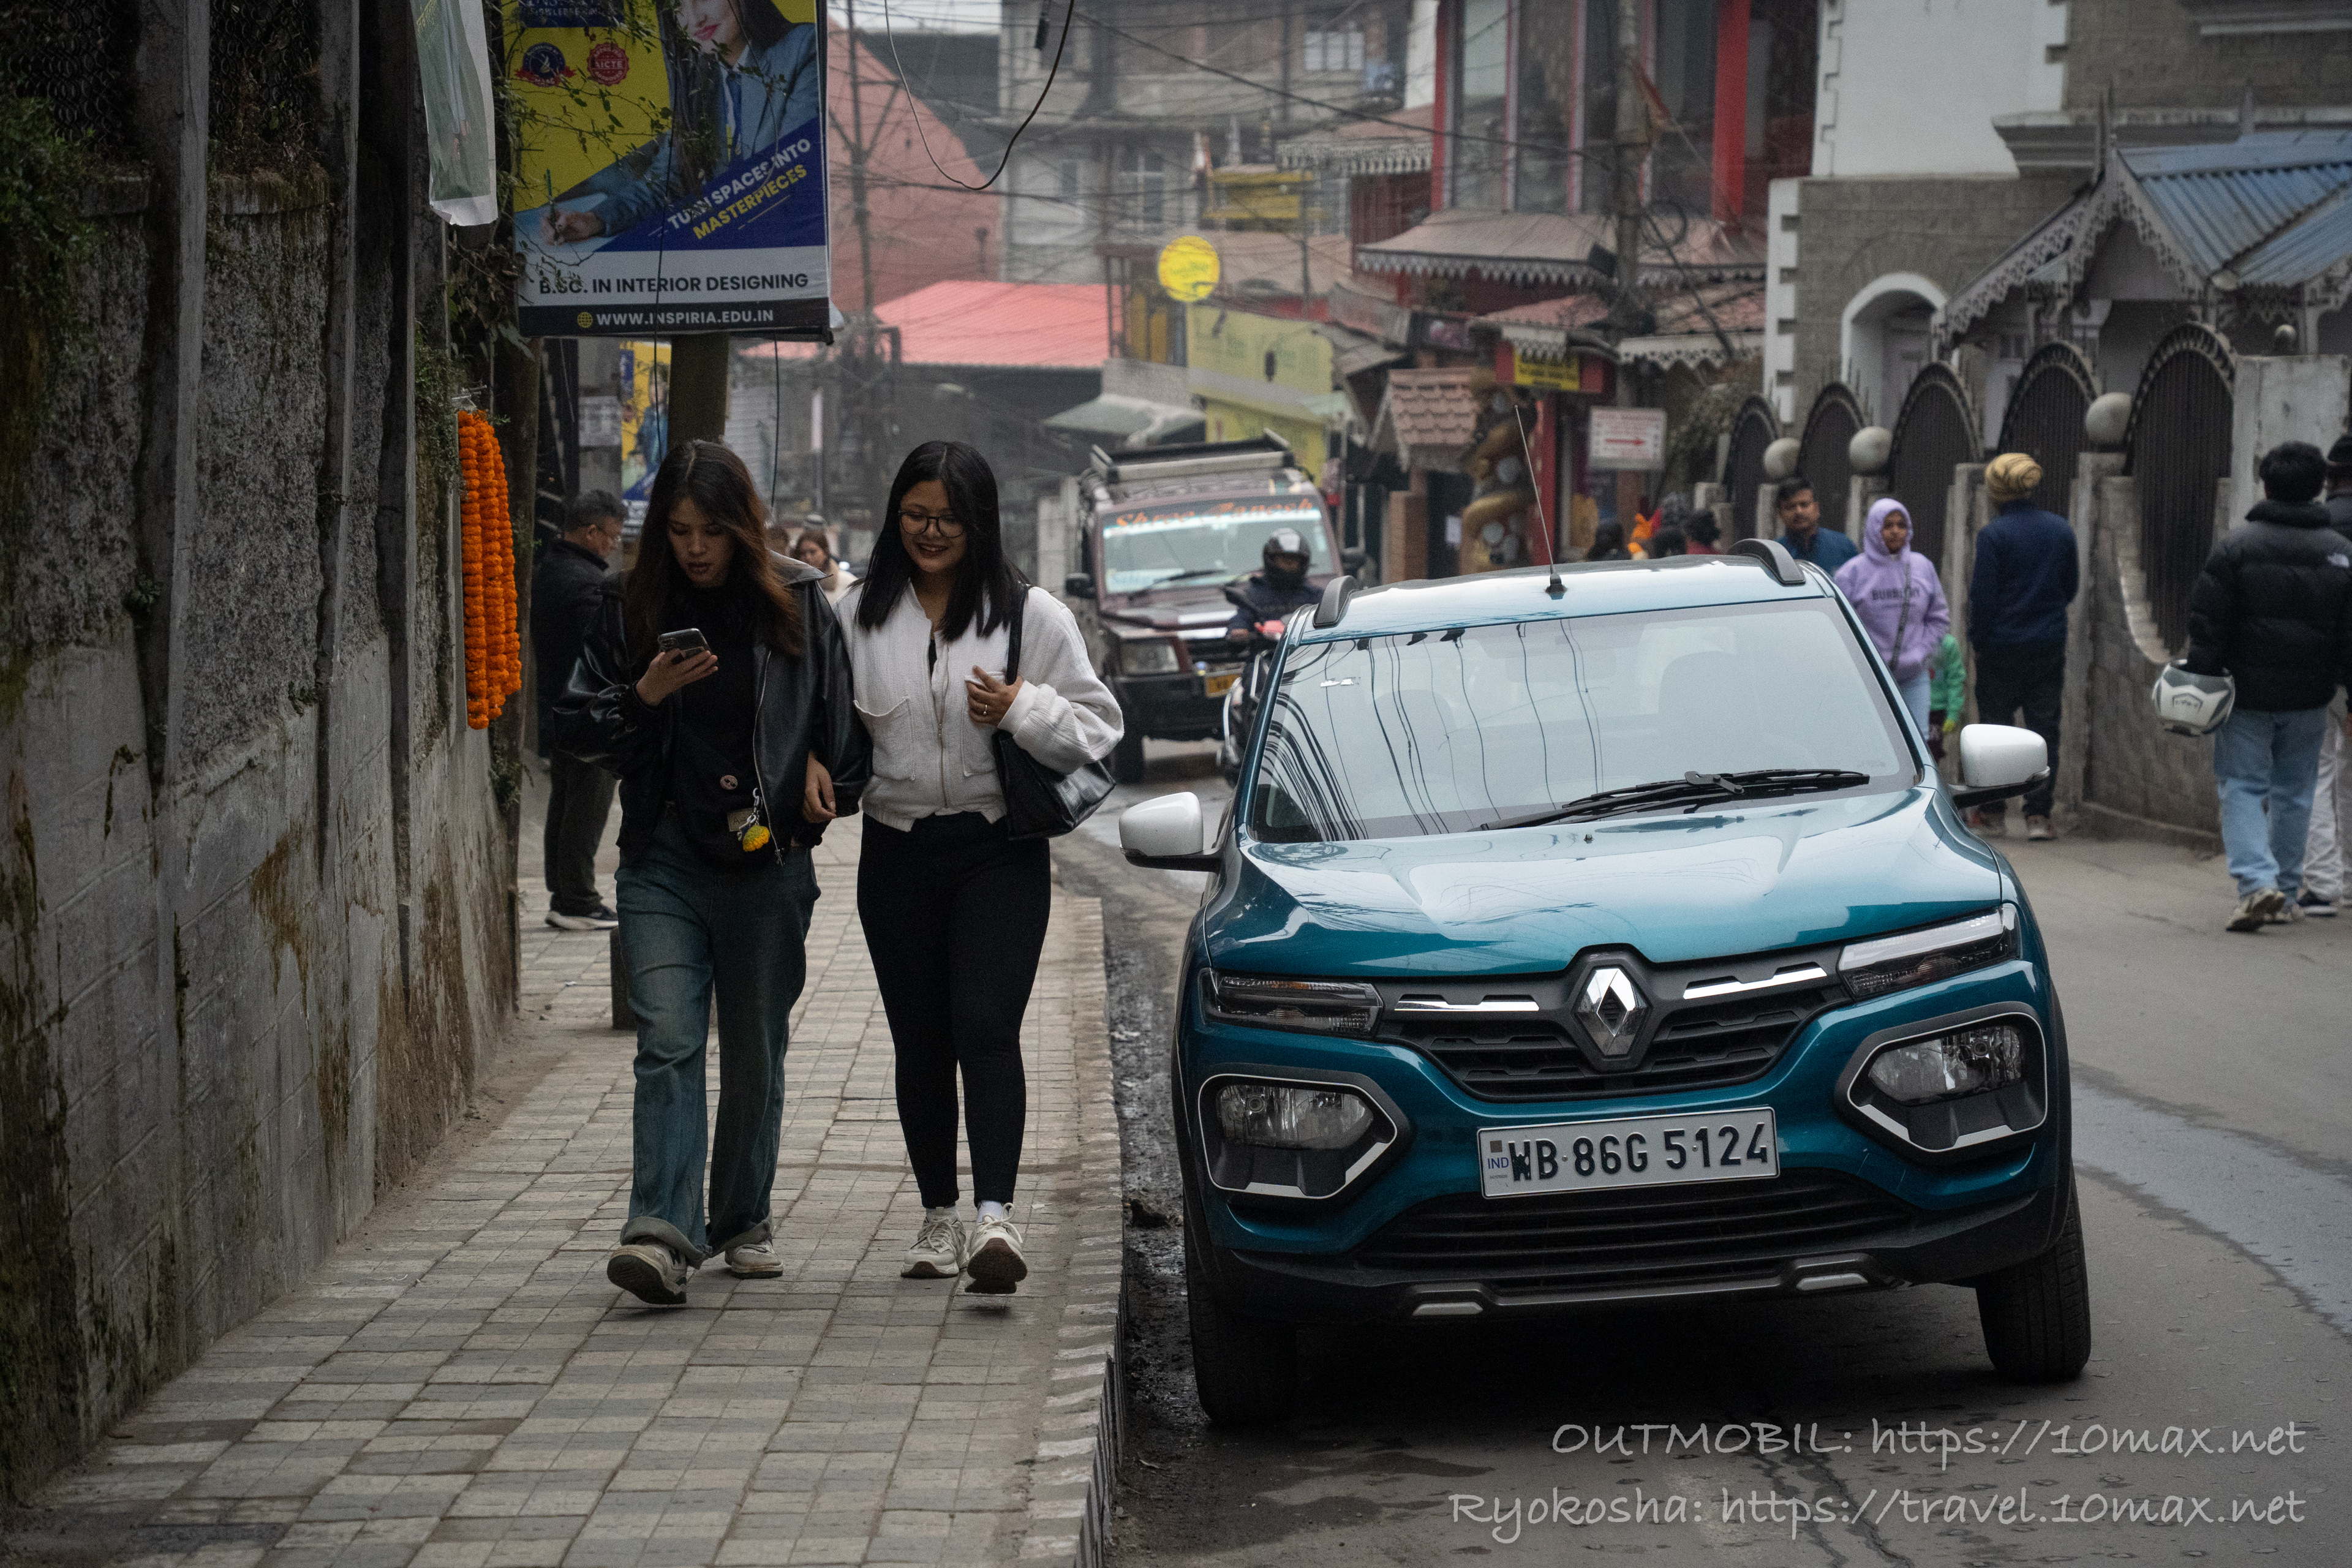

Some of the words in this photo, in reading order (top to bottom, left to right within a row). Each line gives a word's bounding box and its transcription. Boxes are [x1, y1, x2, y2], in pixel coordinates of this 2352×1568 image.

[710, 161, 773, 205] SPACES
[770, 138, 811, 168] INTO
[693, 164, 807, 239] MASTERPIECES
[592, 278, 611, 293] IN
[616, 277, 701, 293] INTERIOR
[706, 273, 809, 290] DESIGNING
[597, 309, 774, 325] WWW.INSPIRIA.EDU.IN
[1487, 1156, 1509, 1170] IND
[1508, 1139, 1559, 1182] WB
[1572, 1132, 1648, 1177] 86G
[1663, 1122, 1769, 1170] 5124
